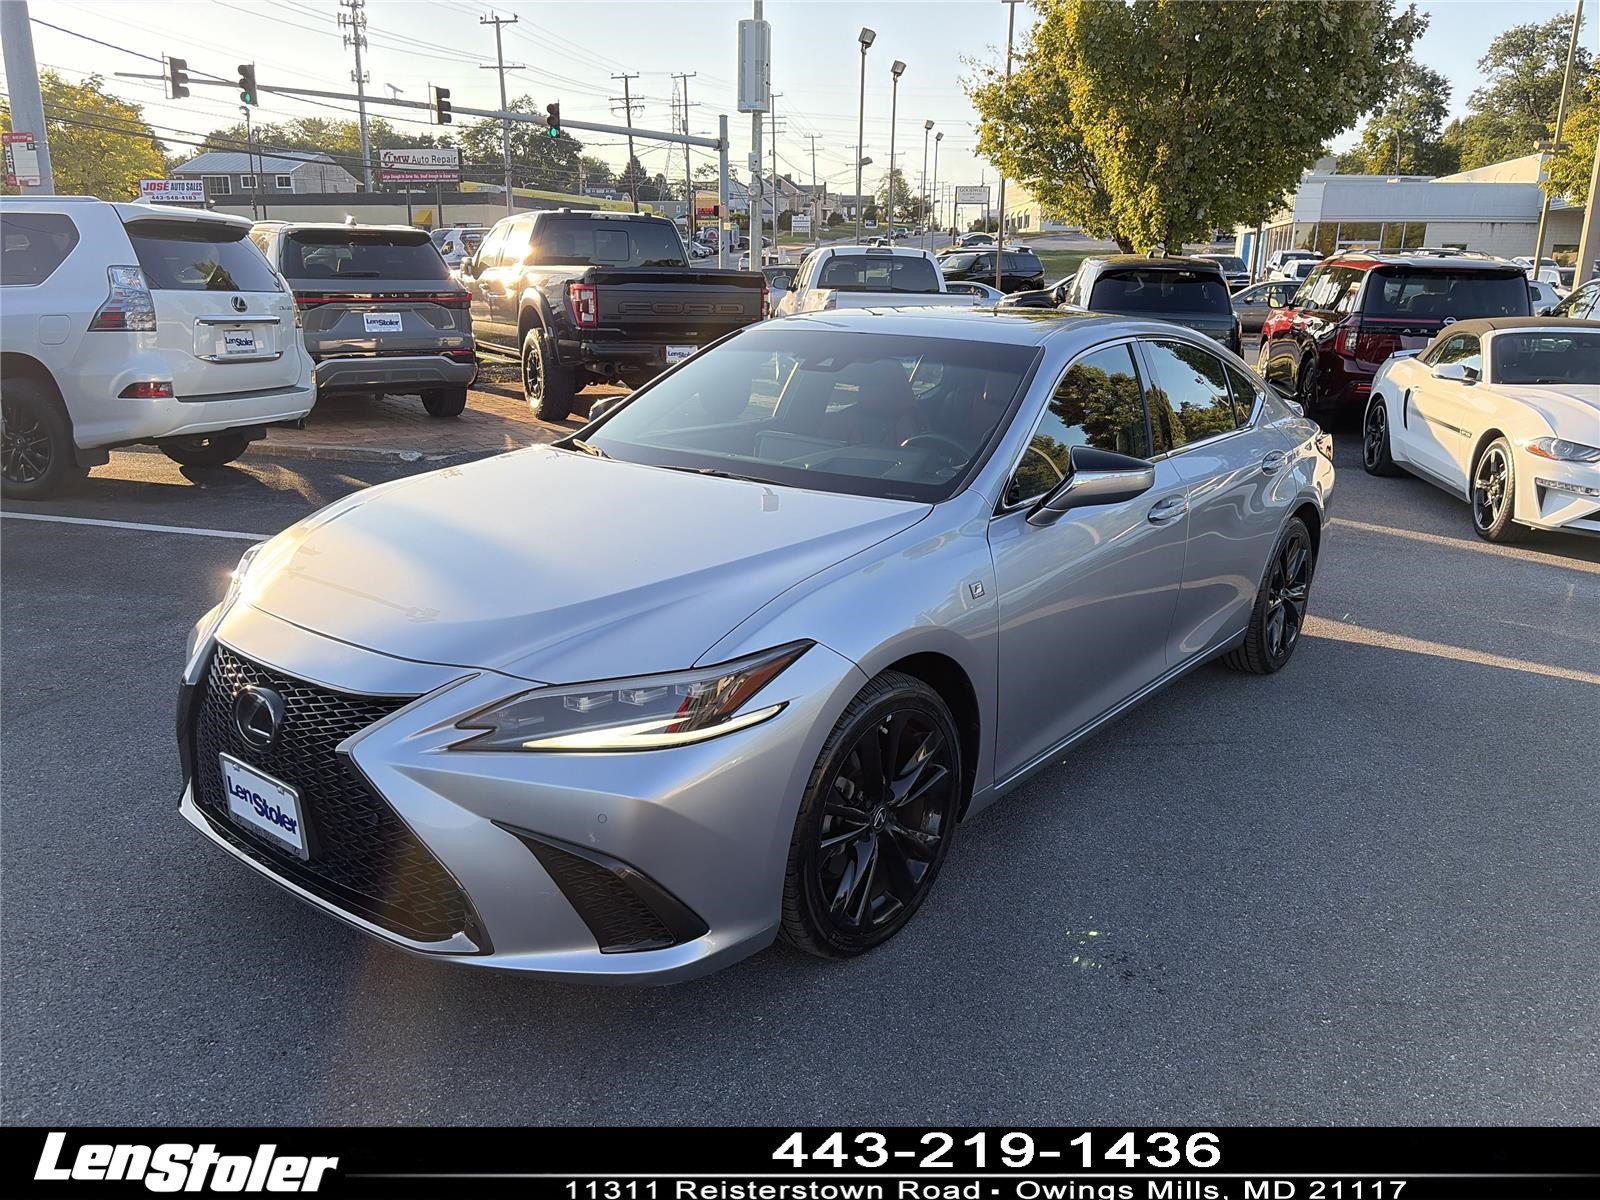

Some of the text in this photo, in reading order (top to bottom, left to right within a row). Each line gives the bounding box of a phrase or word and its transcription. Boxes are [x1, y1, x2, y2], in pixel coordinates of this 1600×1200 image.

[412, 155, 429, 163] Auto
[431, 154, 457, 164] Repair
[142, 181, 203, 191] JOSÉ AUTO SALES
[618, 302, 744, 314] FORD
